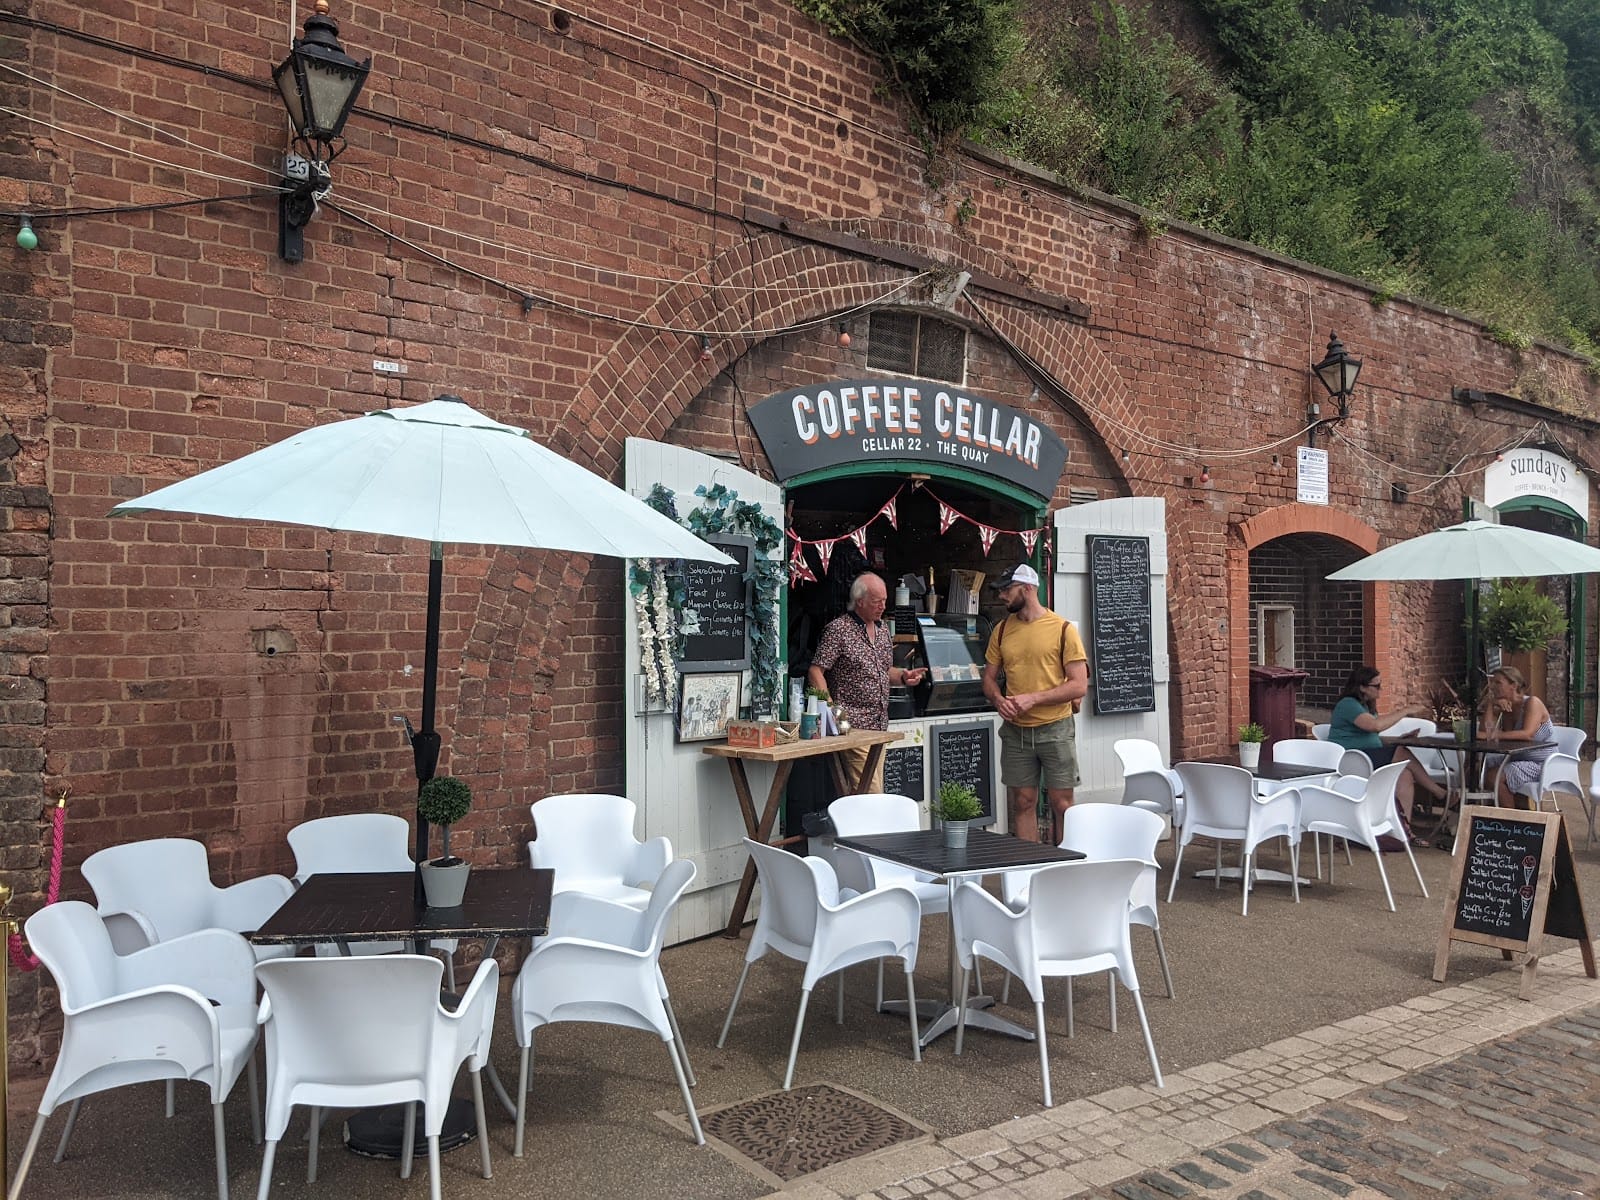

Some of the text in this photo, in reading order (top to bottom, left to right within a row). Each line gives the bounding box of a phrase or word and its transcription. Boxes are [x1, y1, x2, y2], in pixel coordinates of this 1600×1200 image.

[288, 159, 306, 175] 25
[791, 386, 1042, 470] COFFEE CELLAR
[862, 438, 990, 465] CELLAR 22 THE QUAY
[1510, 453, 1567, 483] sundays
[1100, 540, 1114, 552] The
[1113, 540, 1132, 555] Coffee
[687, 576, 704, 585] Fab
[688, 586, 708, 598] Feast
[1475, 833, 1526, 852] Clotted Cream
[1475, 846, 1511, 863] Strawberry
[1470, 865, 1490, 878] Salted
[1465, 887, 1485, 899] Lemon
[1468, 877, 1518, 897] Mint Choc Chip
[1463, 903, 1482, 914] Waffle
